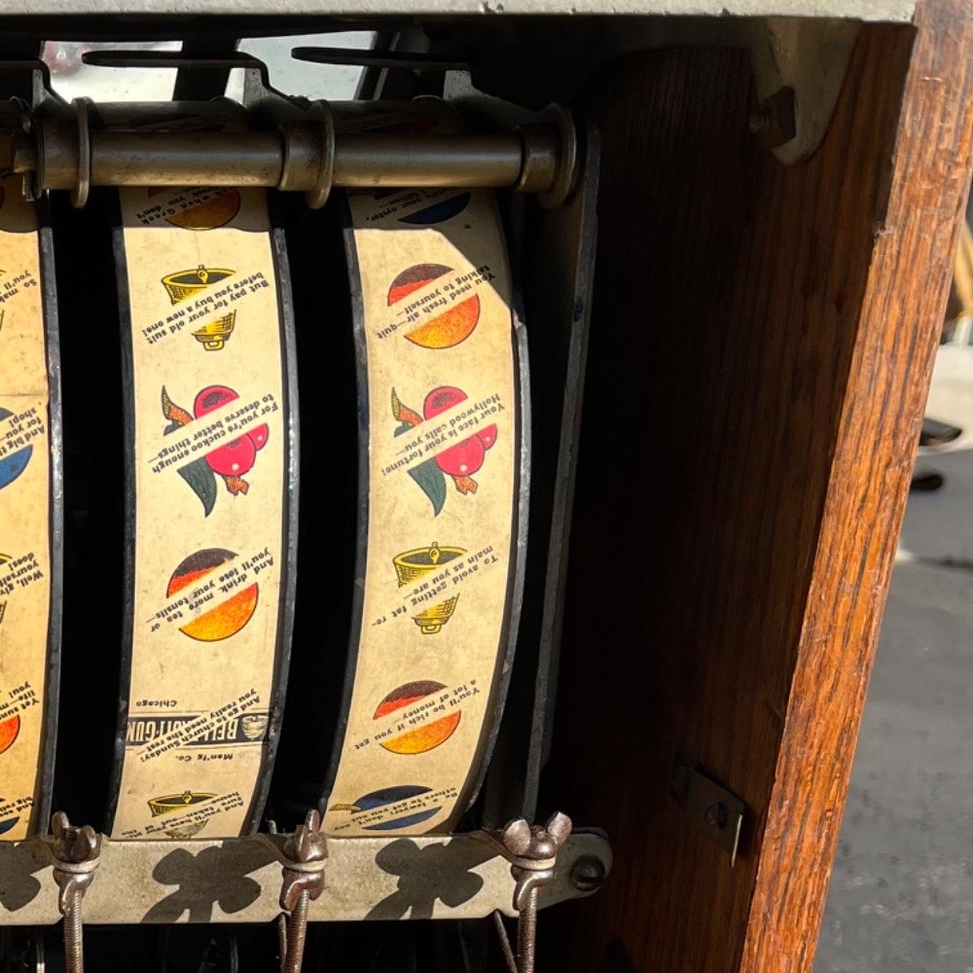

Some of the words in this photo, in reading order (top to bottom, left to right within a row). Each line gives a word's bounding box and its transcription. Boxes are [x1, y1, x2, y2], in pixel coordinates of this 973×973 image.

[166, 194, 185, 208] you
[178, 192, 211, 212] when
[133, 202, 163, 221] don't
[139, 205, 176, 227] Greek
[2, 269, 32, 290] you'll
[232, 271, 264, 290] before
[454, 261, 491, 285] talking
[474, 269, 496, 285] You
[22, 277, 37, 288] So
[248, 278, 270, 293] But
[442, 282, 455, 292] to
[213, 284, 233, 299] you
[229, 287, 247, 302] pay
[448, 282, 472, 301] need
[185, 305, 193, 313] a
[194, 295, 215, 309] buy
[212, 298, 228, 310] for
[421, 296, 448, 313] fresh
[165, 309, 186, 324] new
[188, 305, 211, 323] your
[140, 319, 164, 337] one!
[168, 319, 185, 334] old
[145, 328, 167, 345] suit
[261, 392, 274, 403] to
[223, 399, 260, 423] deserve
[260, 400, 279, 416] For
[448, 392, 501, 428] Hollywood
[479, 399, 506, 420] Your
[26, 415, 42, 429] for
[226, 409, 259, 433] you're
[457, 415, 479, 432] face
[23, 423, 45, 442] And
[192, 419, 224, 441] better
[423, 422, 447, 440] calls
[446, 428, 458, 438] is
[5, 435, 25, 450] big
[190, 428, 226, 452] cuckoo
[424, 432, 447, 452] your
[151, 446, 190, 473] enough
[7, 551, 36, 572] does!
[240, 546, 271, 571] you'll
[466, 544, 494, 564] main
[482, 553, 498, 565] To
[252, 555, 274, 575] And
[452, 561, 464, 572] as
[15, 569, 44, 587] Well,
[217, 567, 239, 582] lose
[431, 567, 451, 585] you
[451, 563, 479, 585] avoid
[191, 578, 216, 599] your
[409, 580, 447, 606] getting
[187, 591, 214, 611] more
[165, 610, 183, 623] tea
[390, 604, 407, 618] fat
[150, 622, 161, 633] or
[7, 680, 31, 699] you!
[452, 683, 468, 696] lot
[469, 678, 476, 686] a
[237, 687, 257, 703] you
[438, 692, 449, 703] of
[448, 686, 480, 707] You'll
[19, 696, 40, 710] Yet
[135, 698, 178, 708] Chicago
[209, 700, 237, 719] really
[239, 694, 260, 712] And
[432, 703, 446, 713] be
[215, 714, 227, 724] to
[226, 706, 239, 717] go
[407, 710, 429, 725] rich
[183, 716, 208, 734] need
[396, 722, 405, 731] if
[165, 729, 184, 741] the
[180, 721, 215, 745] church
[373, 727, 393, 741] you
[353, 737, 370, 750] get
[174, 754, 192, 762] Co.
[15, 795, 34, 805] big
[423, 786, 456, 800] others
[15, 799, 36, 812] And
[223, 800, 244, 812] And
[370, 807, 389, 816] you
[391, 801, 408, 811] get
[193, 807, 222, 821] you'll
[356, 814, 384, 826] don't
[145, 823, 167, 835] your
[168, 818, 192, 827] have
